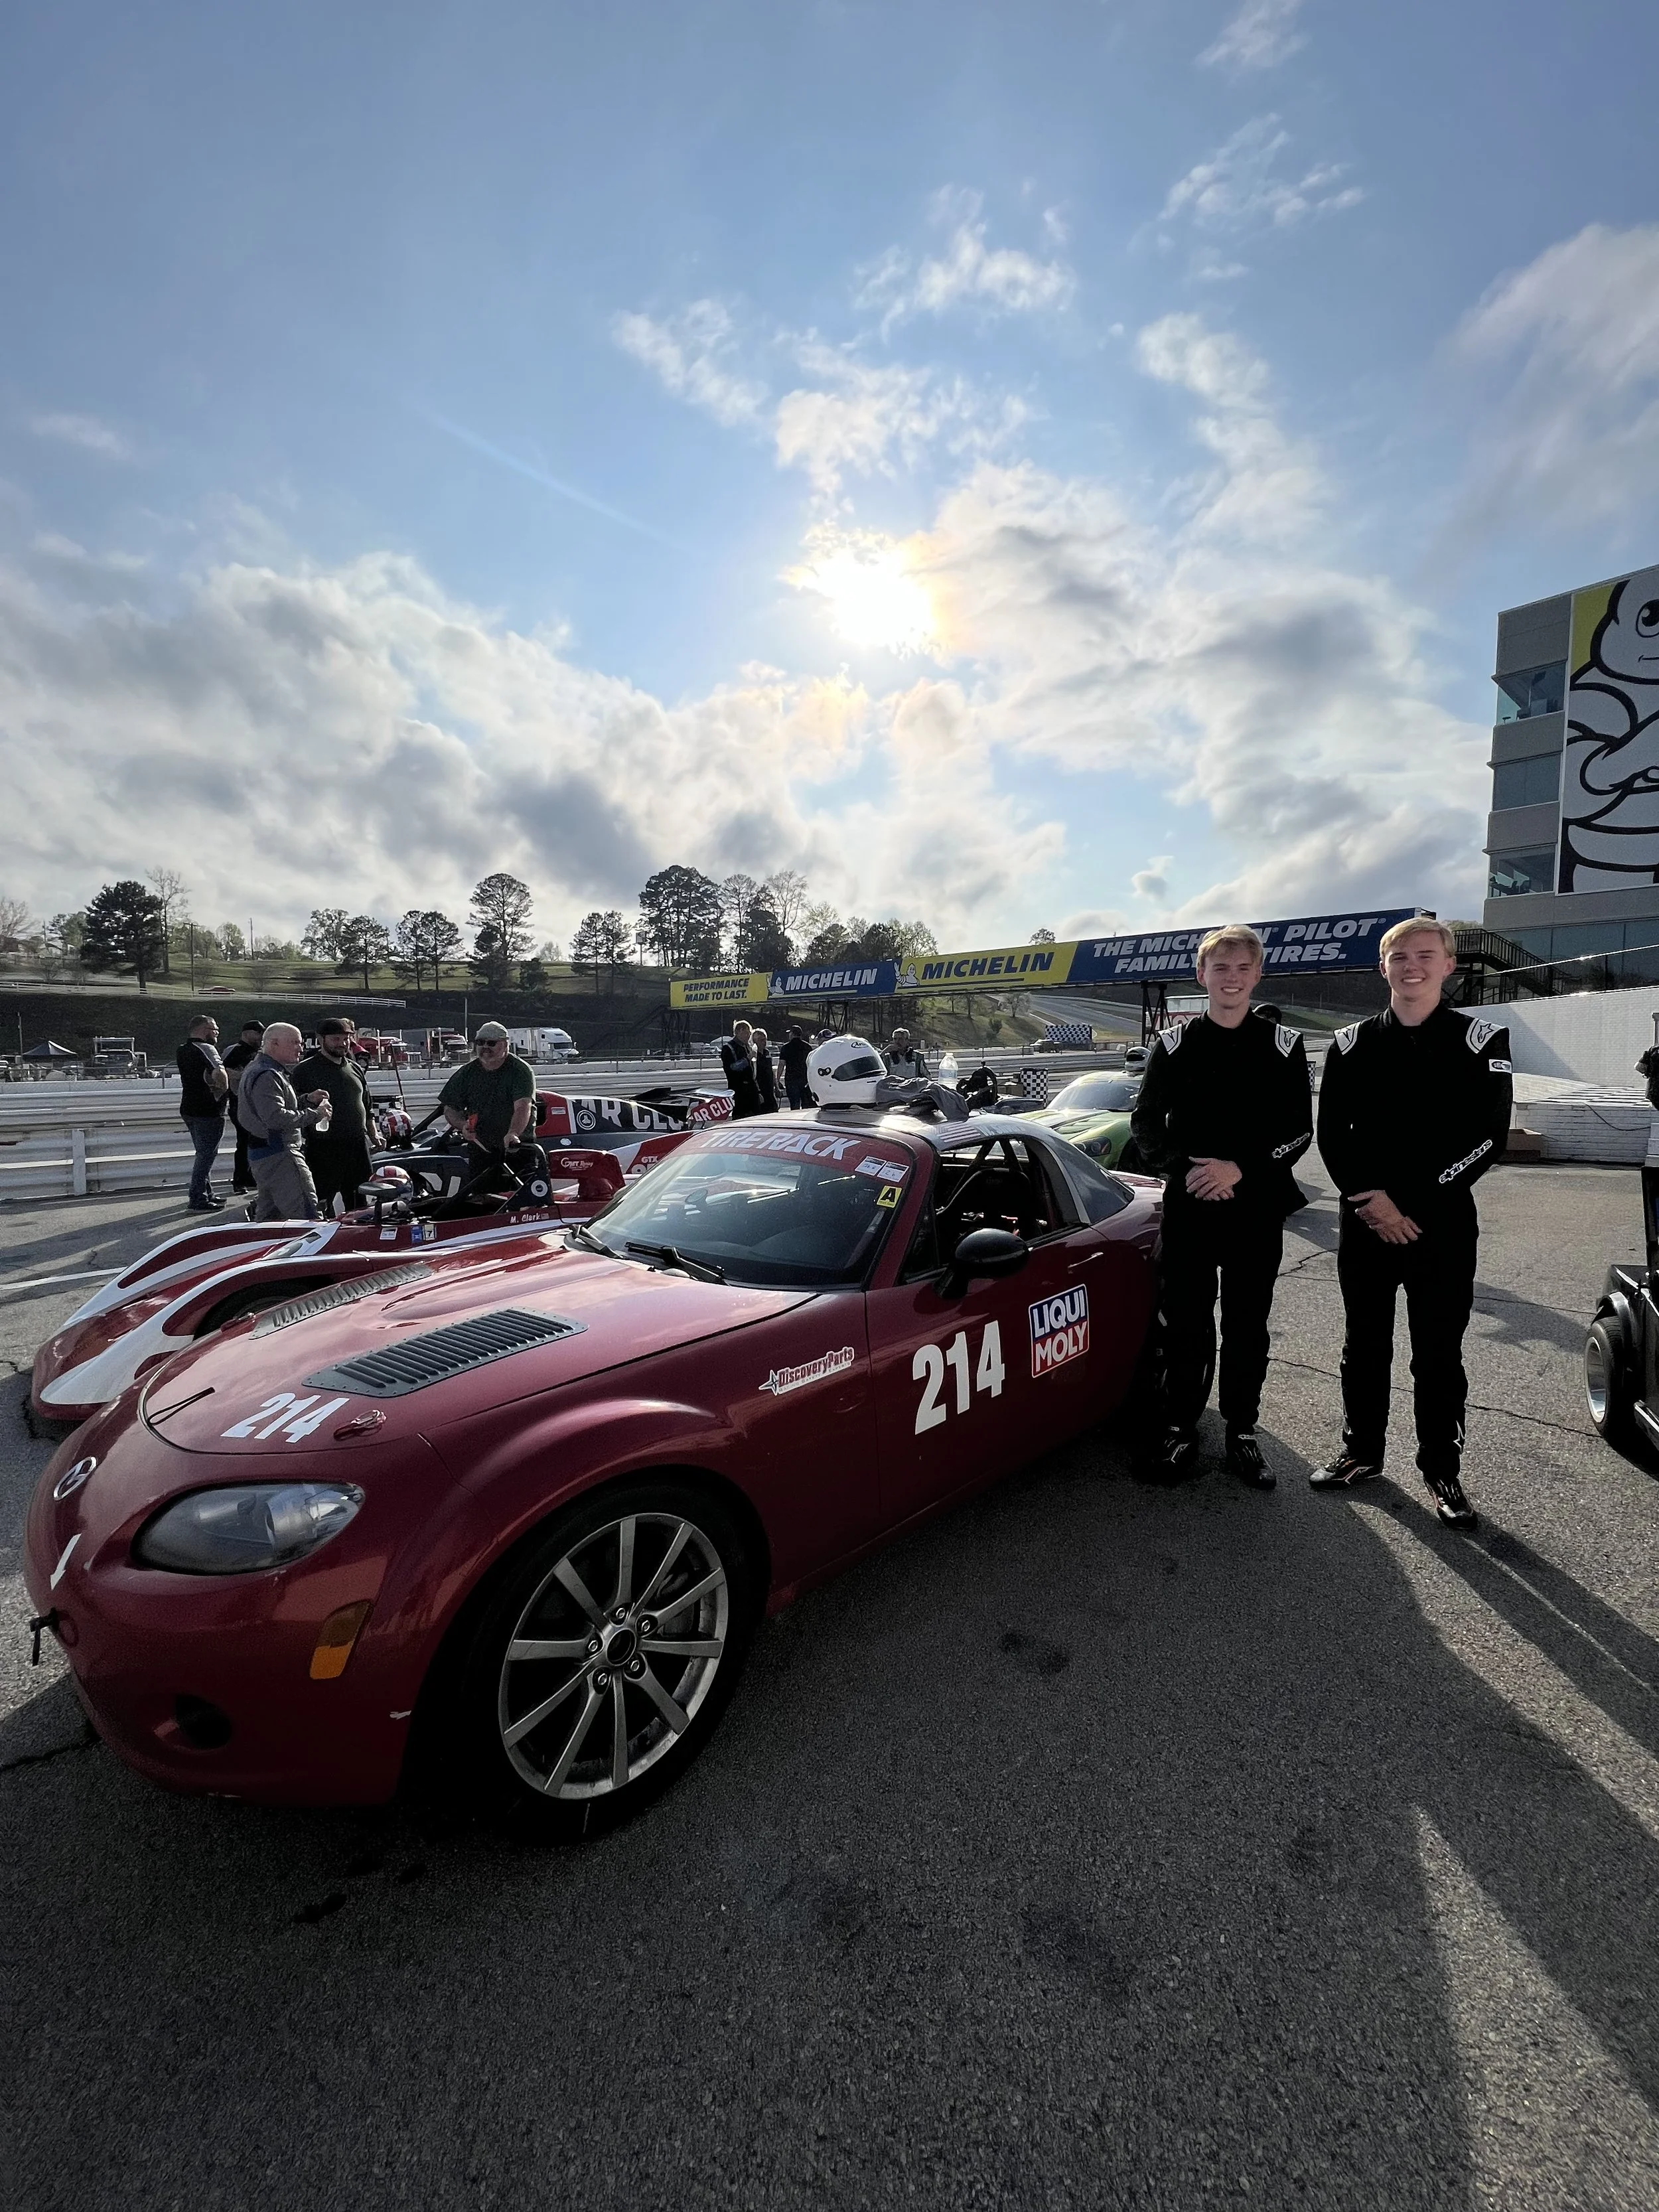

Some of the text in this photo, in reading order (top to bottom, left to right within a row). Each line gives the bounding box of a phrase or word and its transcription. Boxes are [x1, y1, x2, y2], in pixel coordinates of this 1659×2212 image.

[1094, 939, 1137, 958] THE
[921, 952, 1054, 980] MICHELIN
[684, 978, 750, 992] PERFORMANCE
[786, 968, 878, 992] MICHELIN
[685, 990, 747, 1002] MADE TO LAST.
[880, 1187, 897, 1203] A
[522, 1213, 541, 1222] Clark
[1033, 1290, 1086, 1338] LIQUI
[1035, 1321, 1088, 1372] MOLY
[912, 1320, 1005, 1435] 214
[220, 1392, 350, 1443] 214
